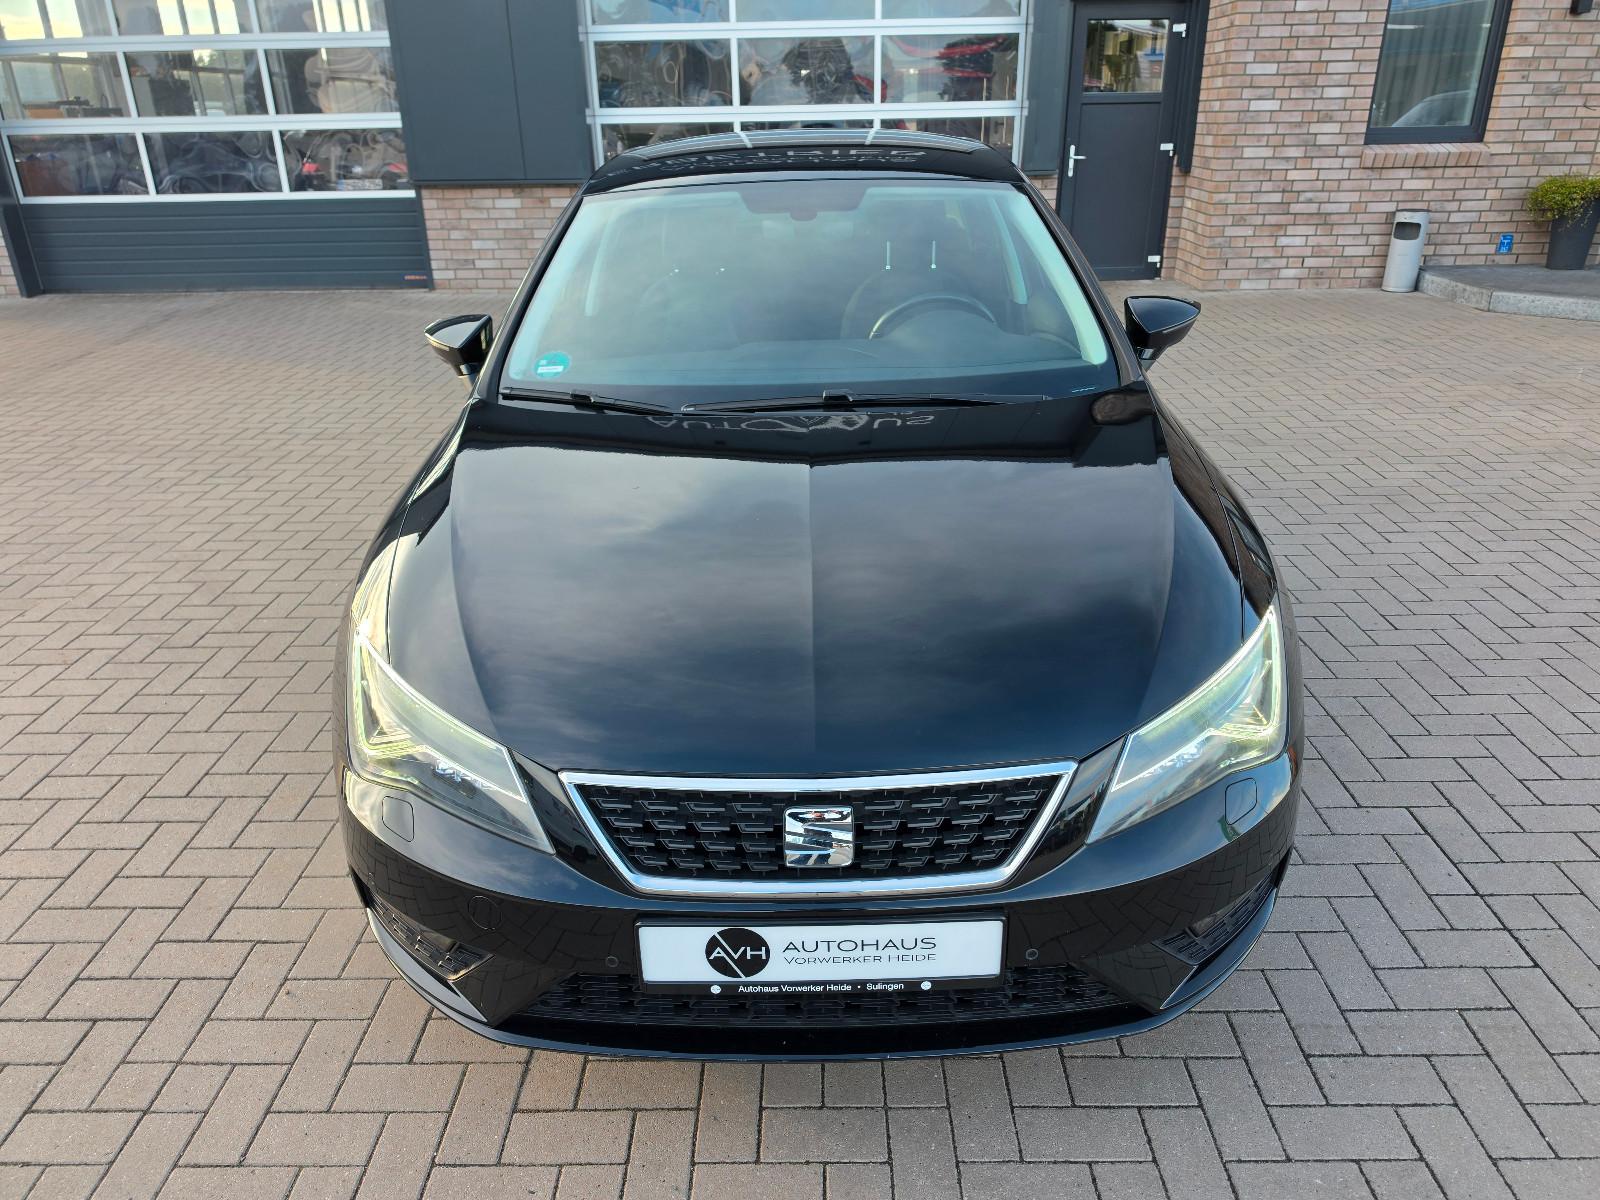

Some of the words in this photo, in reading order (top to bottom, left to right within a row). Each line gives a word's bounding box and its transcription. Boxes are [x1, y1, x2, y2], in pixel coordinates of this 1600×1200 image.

[782, 937, 937, 953] AUTOHAUS
[783, 955, 882, 965] VORWERKER
[888, 953, 937, 963] HEIDE
[738, 985, 779, 993] Autohaus
[780, 984, 825, 992] Vorwerker
[826, 983, 852, 991] Heide
[866, 983, 904, 991] Sulingen
